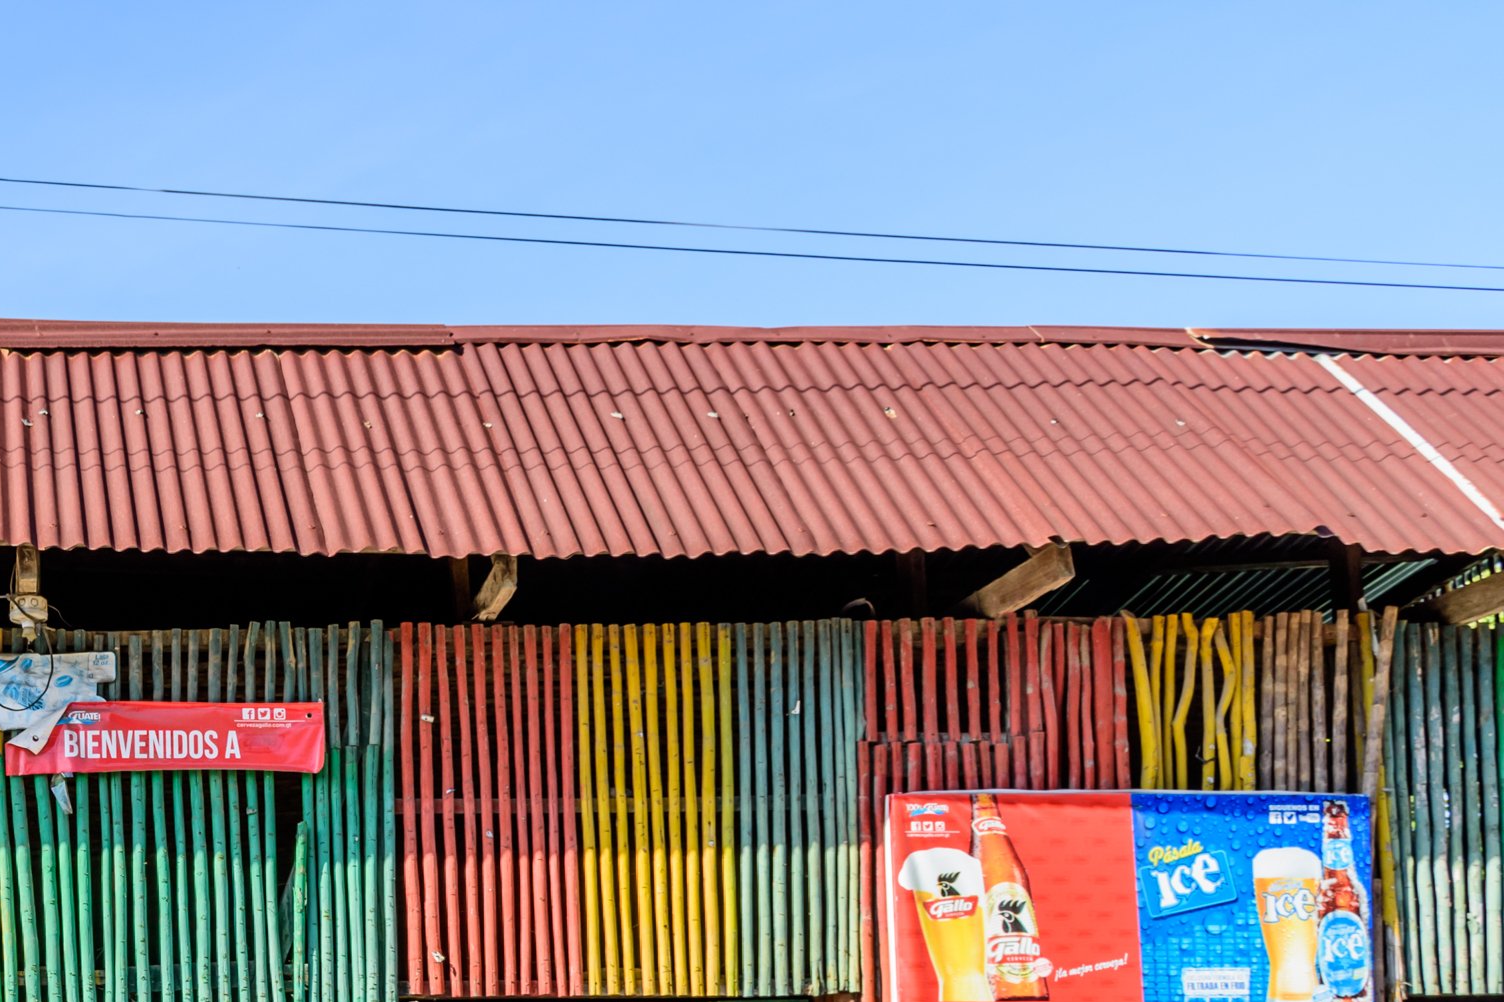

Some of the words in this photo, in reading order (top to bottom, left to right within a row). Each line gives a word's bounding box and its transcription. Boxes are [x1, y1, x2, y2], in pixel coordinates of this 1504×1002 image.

[64, 729, 219, 759] BIENVENIDOS
[225, 730, 242, 759] A
[929, 899, 974, 917] Gallo
[986, 936, 1041, 963] Gallo
